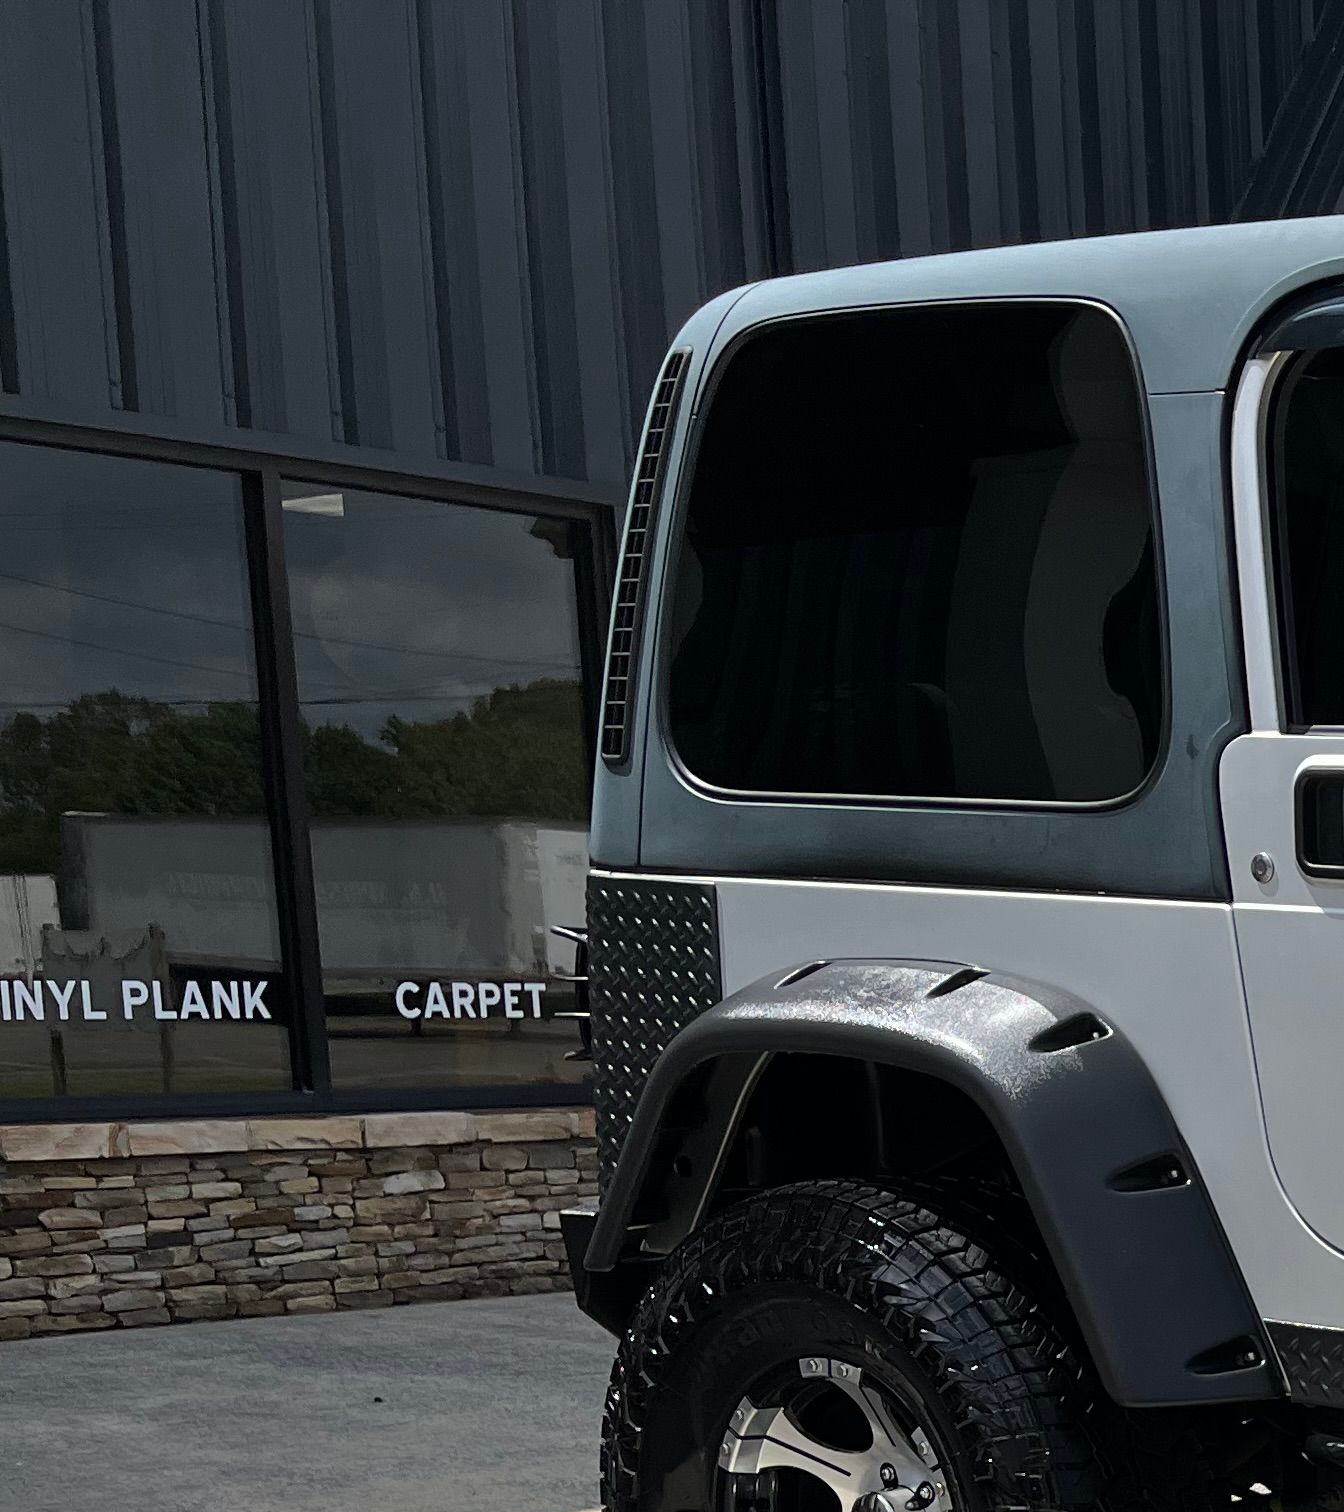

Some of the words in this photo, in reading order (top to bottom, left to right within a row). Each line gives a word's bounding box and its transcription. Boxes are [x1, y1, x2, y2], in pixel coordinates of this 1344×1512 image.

[0, 979, 107, 1020] INYL
[122, 979, 272, 1020] PLANK
[395, 981, 546, 1019] CARPET
